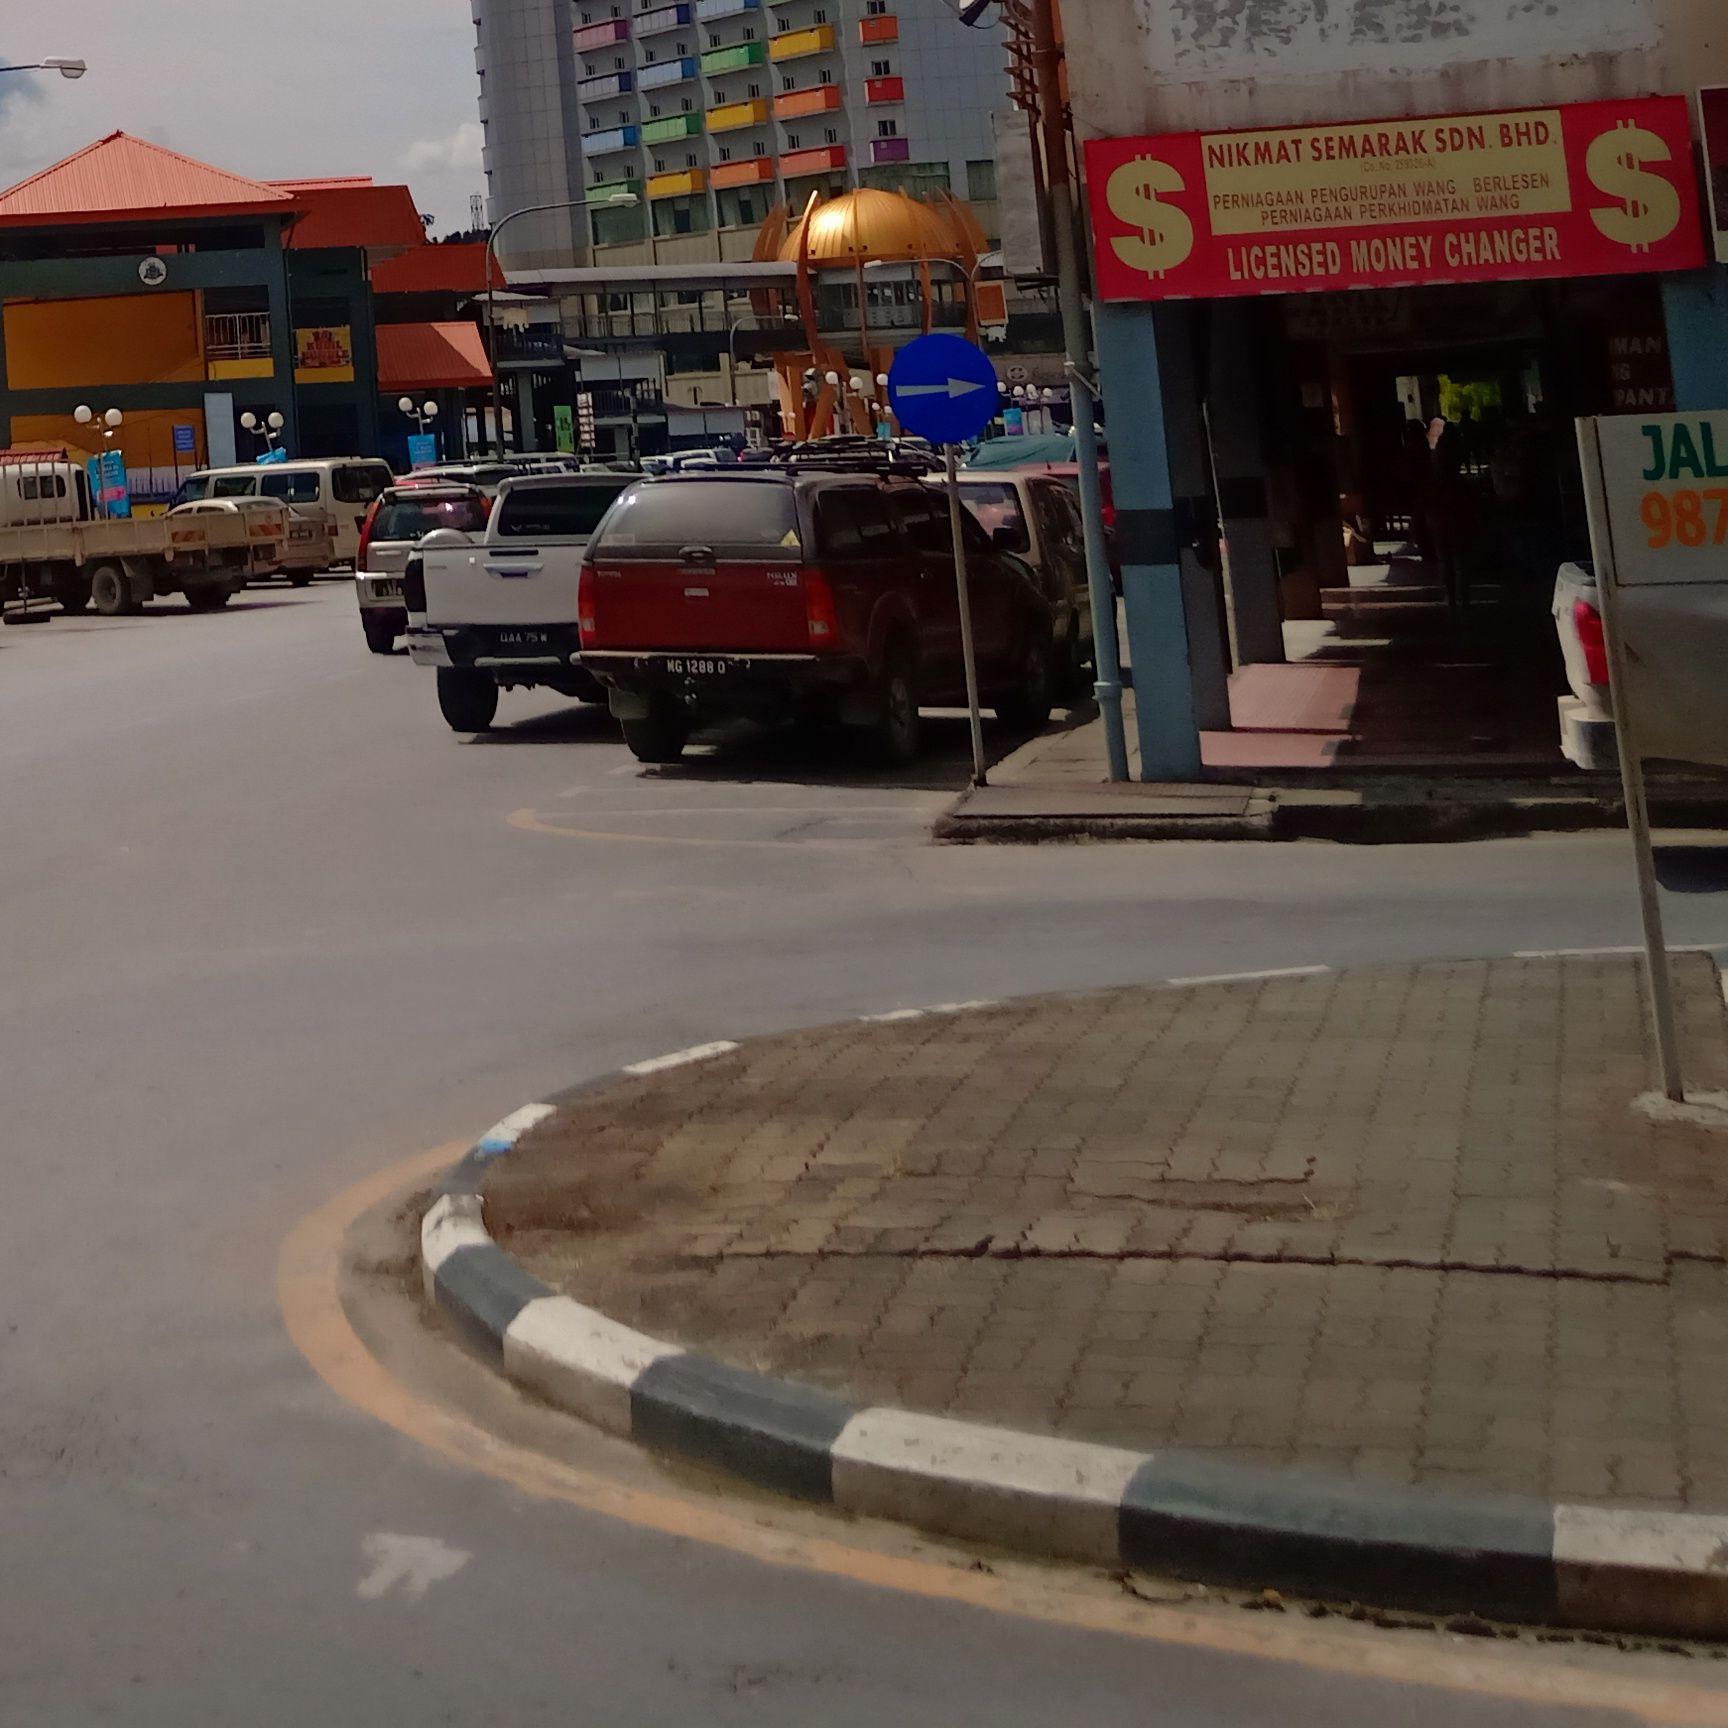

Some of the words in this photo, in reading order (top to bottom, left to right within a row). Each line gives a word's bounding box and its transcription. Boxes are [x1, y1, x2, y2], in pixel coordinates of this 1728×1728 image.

[1208, 139, 1302, 168] NIKMAT
[1310, 129, 1427, 161] SEMARAK
[1434, 125, 1493, 153] SDN.
[1499, 121, 1557, 148] BHD.
[1213, 191, 1304, 209] PERNIAGAAN
[1311, 183, 1406, 204] PENGURUPAN
[1413, 179, 1456, 197] WANG
[1473, 173, 1549, 193] BERLESEN
[1261, 206, 1352, 225] PERNIAGAAN
[1360, 197, 1470, 220] PERKHIDMATAN
[1476, 194, 1520, 212] WANG
[1227, 241, 1341, 280] LICENSED
[1350, 235, 1432, 272] MONEY
[1444, 227, 1561, 267] CHANGER
[1641, 422, 1728, 480] JAL
[1641, 488, 1728, 549] 987
